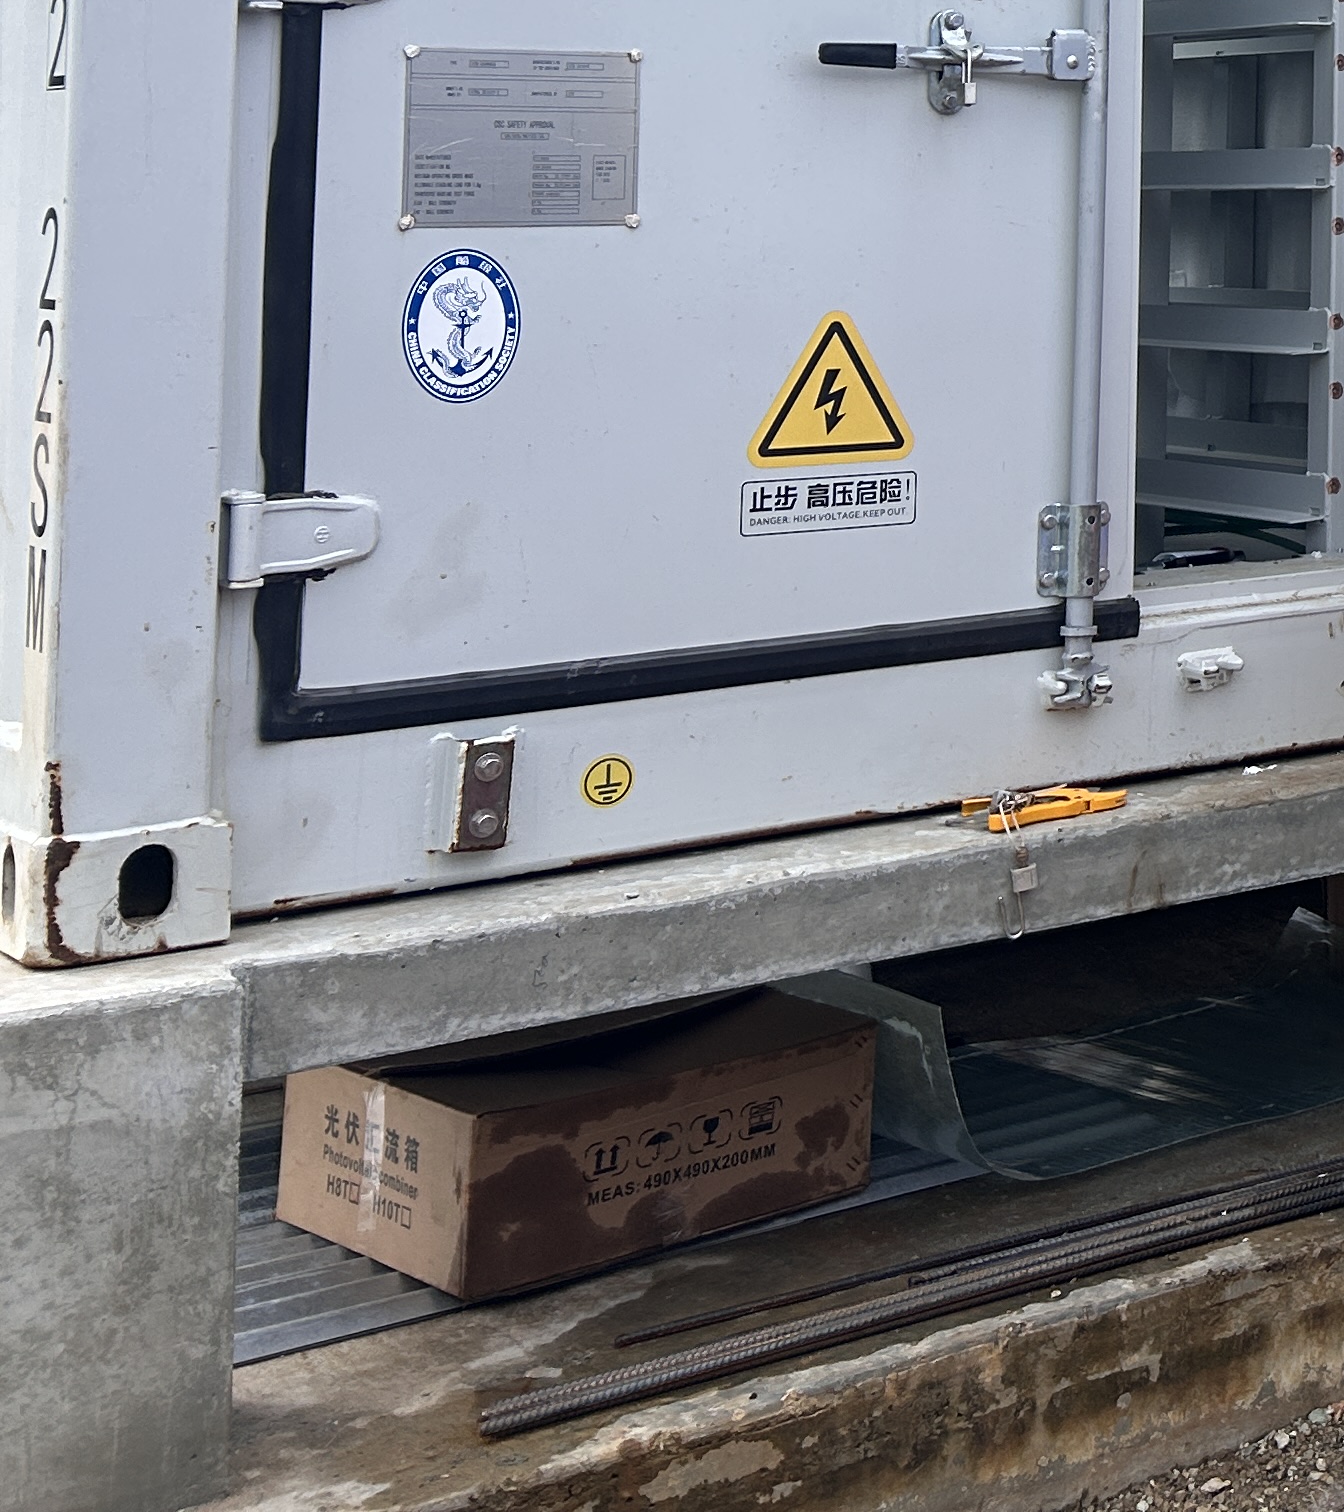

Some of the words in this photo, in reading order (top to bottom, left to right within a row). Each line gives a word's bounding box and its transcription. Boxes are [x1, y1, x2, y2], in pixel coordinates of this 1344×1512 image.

[507, 120, 527, 129] SAFETY
[407, 332, 420, 368] CHINA
[419, 367, 498, 397] CLASSIFICATION
[496, 326, 516, 371] SOCIETY
[749, 485, 797, 513] 止步
[793, 513, 817, 523] HIGH
[887, 506, 907, 517] OUT
[643, 1143, 776, 1190] 490X490X200MM
[379, 1171, 418, 1200] combiner
